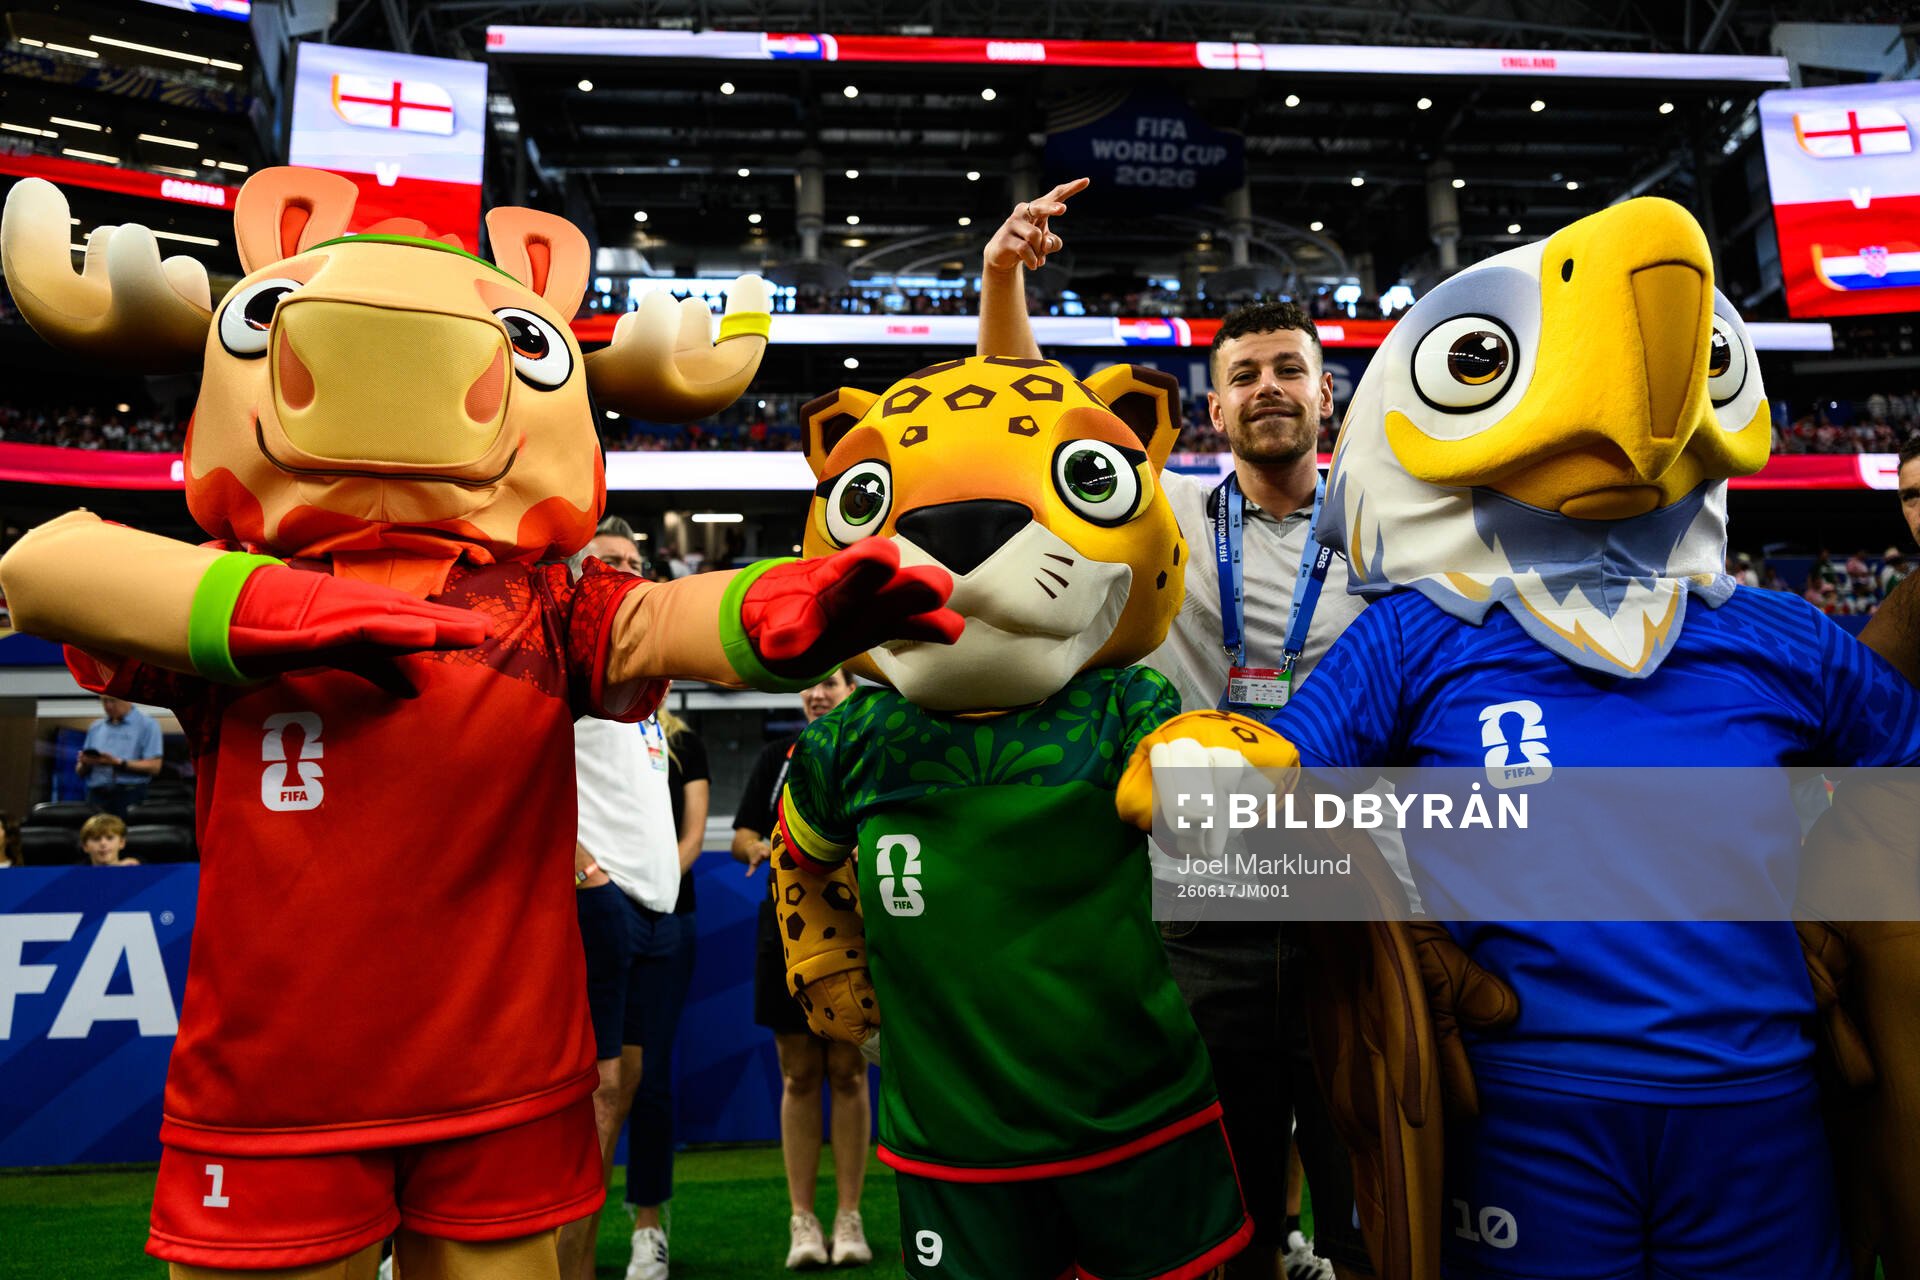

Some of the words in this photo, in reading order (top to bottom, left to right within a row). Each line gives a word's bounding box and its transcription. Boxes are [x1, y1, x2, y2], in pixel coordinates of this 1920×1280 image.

[1500, 56, 1557, 71] ENGLAND
[1135, 116, 1188, 140] FIFA
[1090, 138, 1179, 163] WORLD
[1181, 143, 1228, 165] CUP
[375, 161, 401, 187] V
[1114, 164, 1196, 188] 2026
[161, 179, 226, 206] CROATIA
[1849, 186, 1872, 209] V
[1218, 518, 1227, 544] WORLD
[1219, 544, 1228, 563] FIFA
[1504, 766, 1535, 780] FIFA
[280, 791, 308, 802] FIFA
[892, 900, 914, 911] FIFA
[203, 1164, 230, 1208] 1
[1450, 1197, 1518, 1250] 10
[915, 1230, 943, 1267] 9
